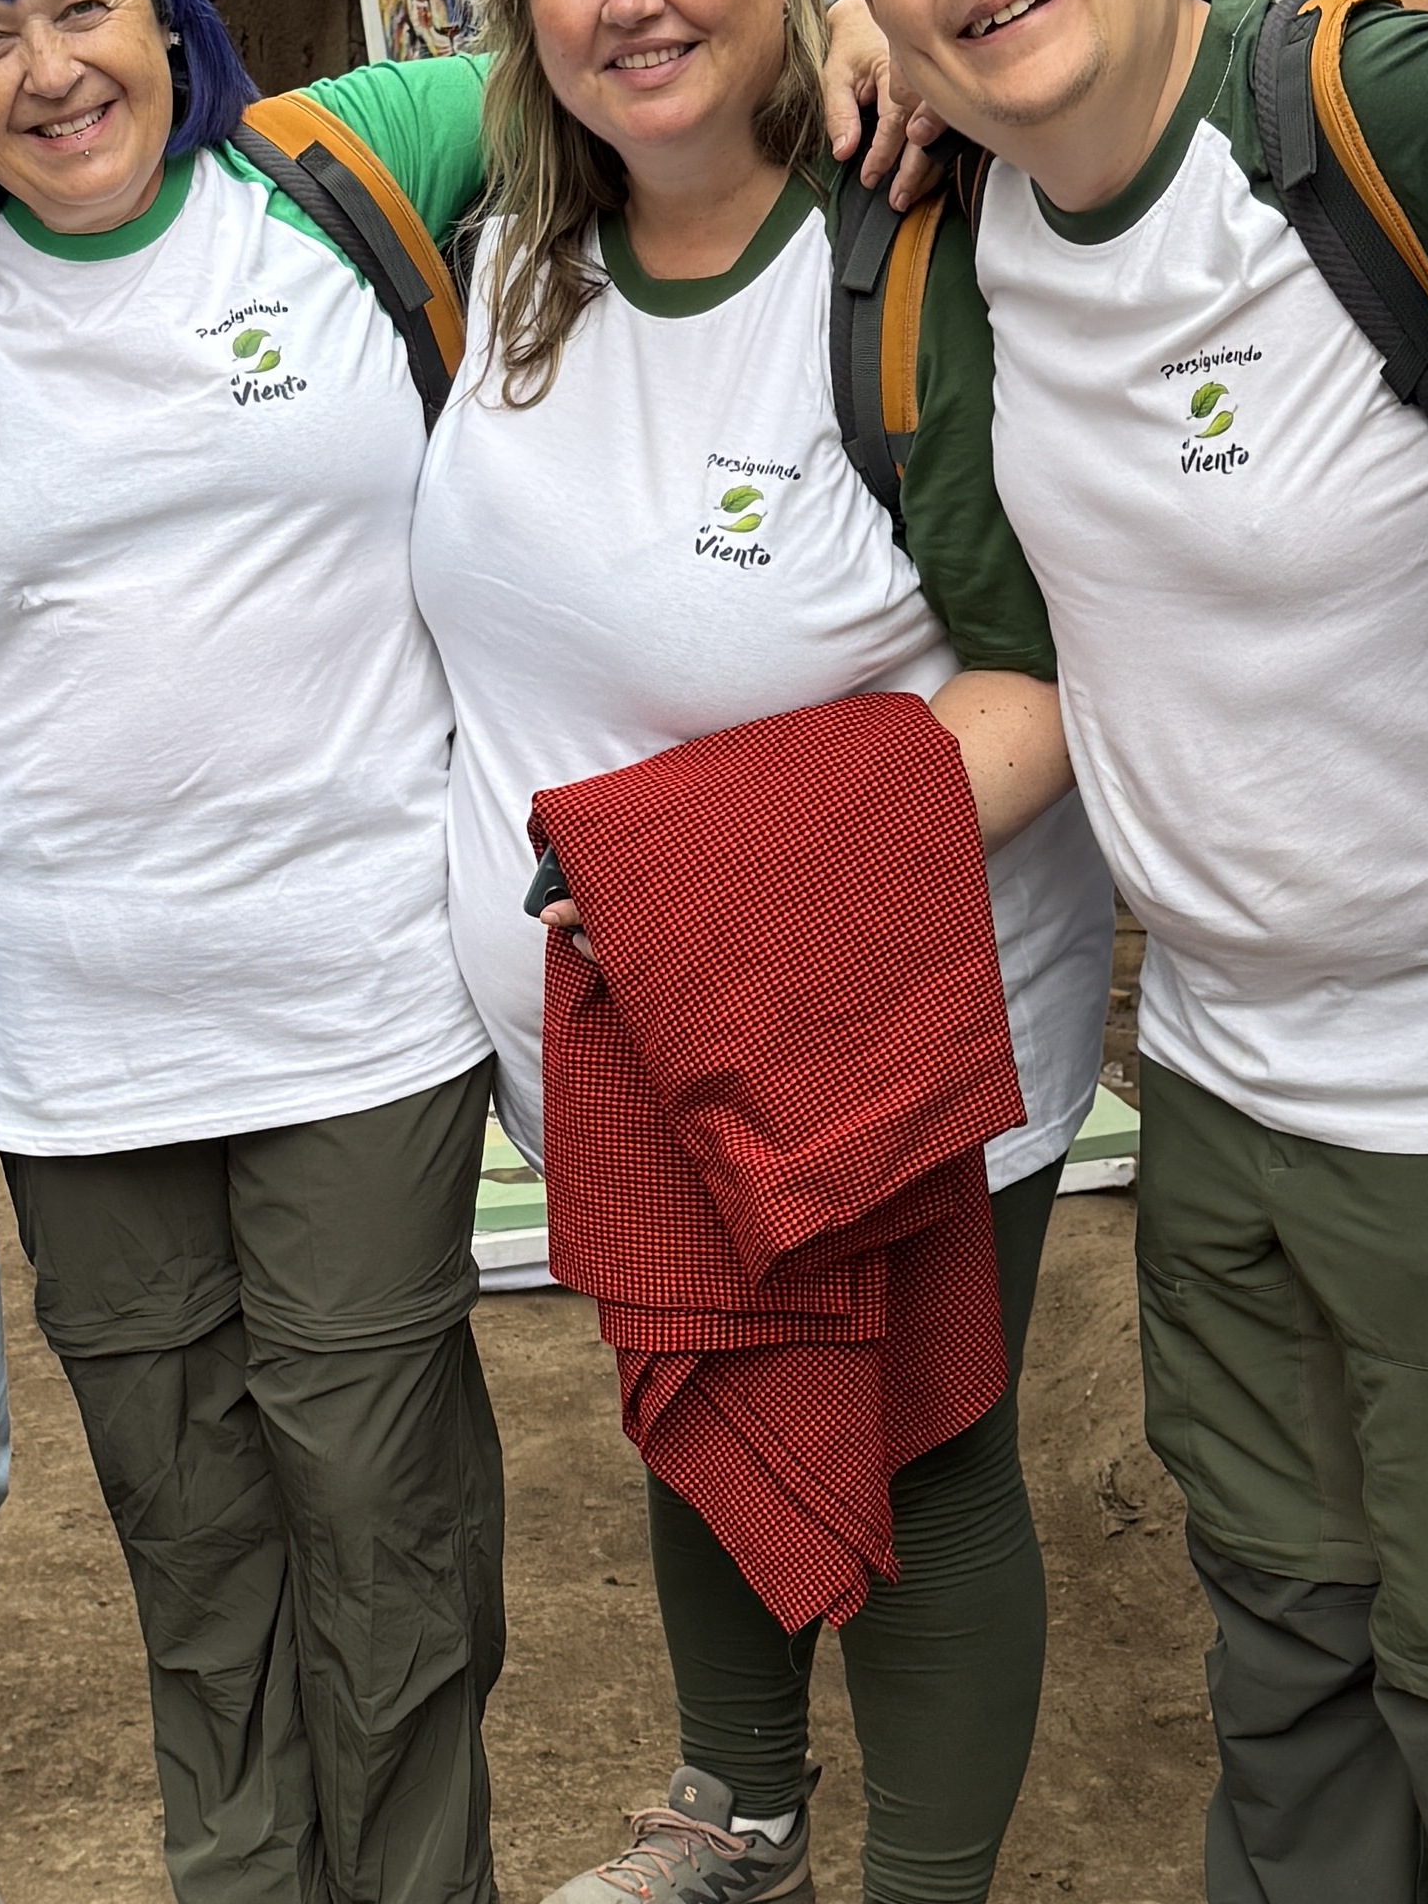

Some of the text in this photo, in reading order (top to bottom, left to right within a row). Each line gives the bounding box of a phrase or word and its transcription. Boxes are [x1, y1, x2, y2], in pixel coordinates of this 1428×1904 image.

[232, 375, 307, 406] Viento
[1180, 442, 1249, 474] Viento
[695, 535, 771, 570] Viento
